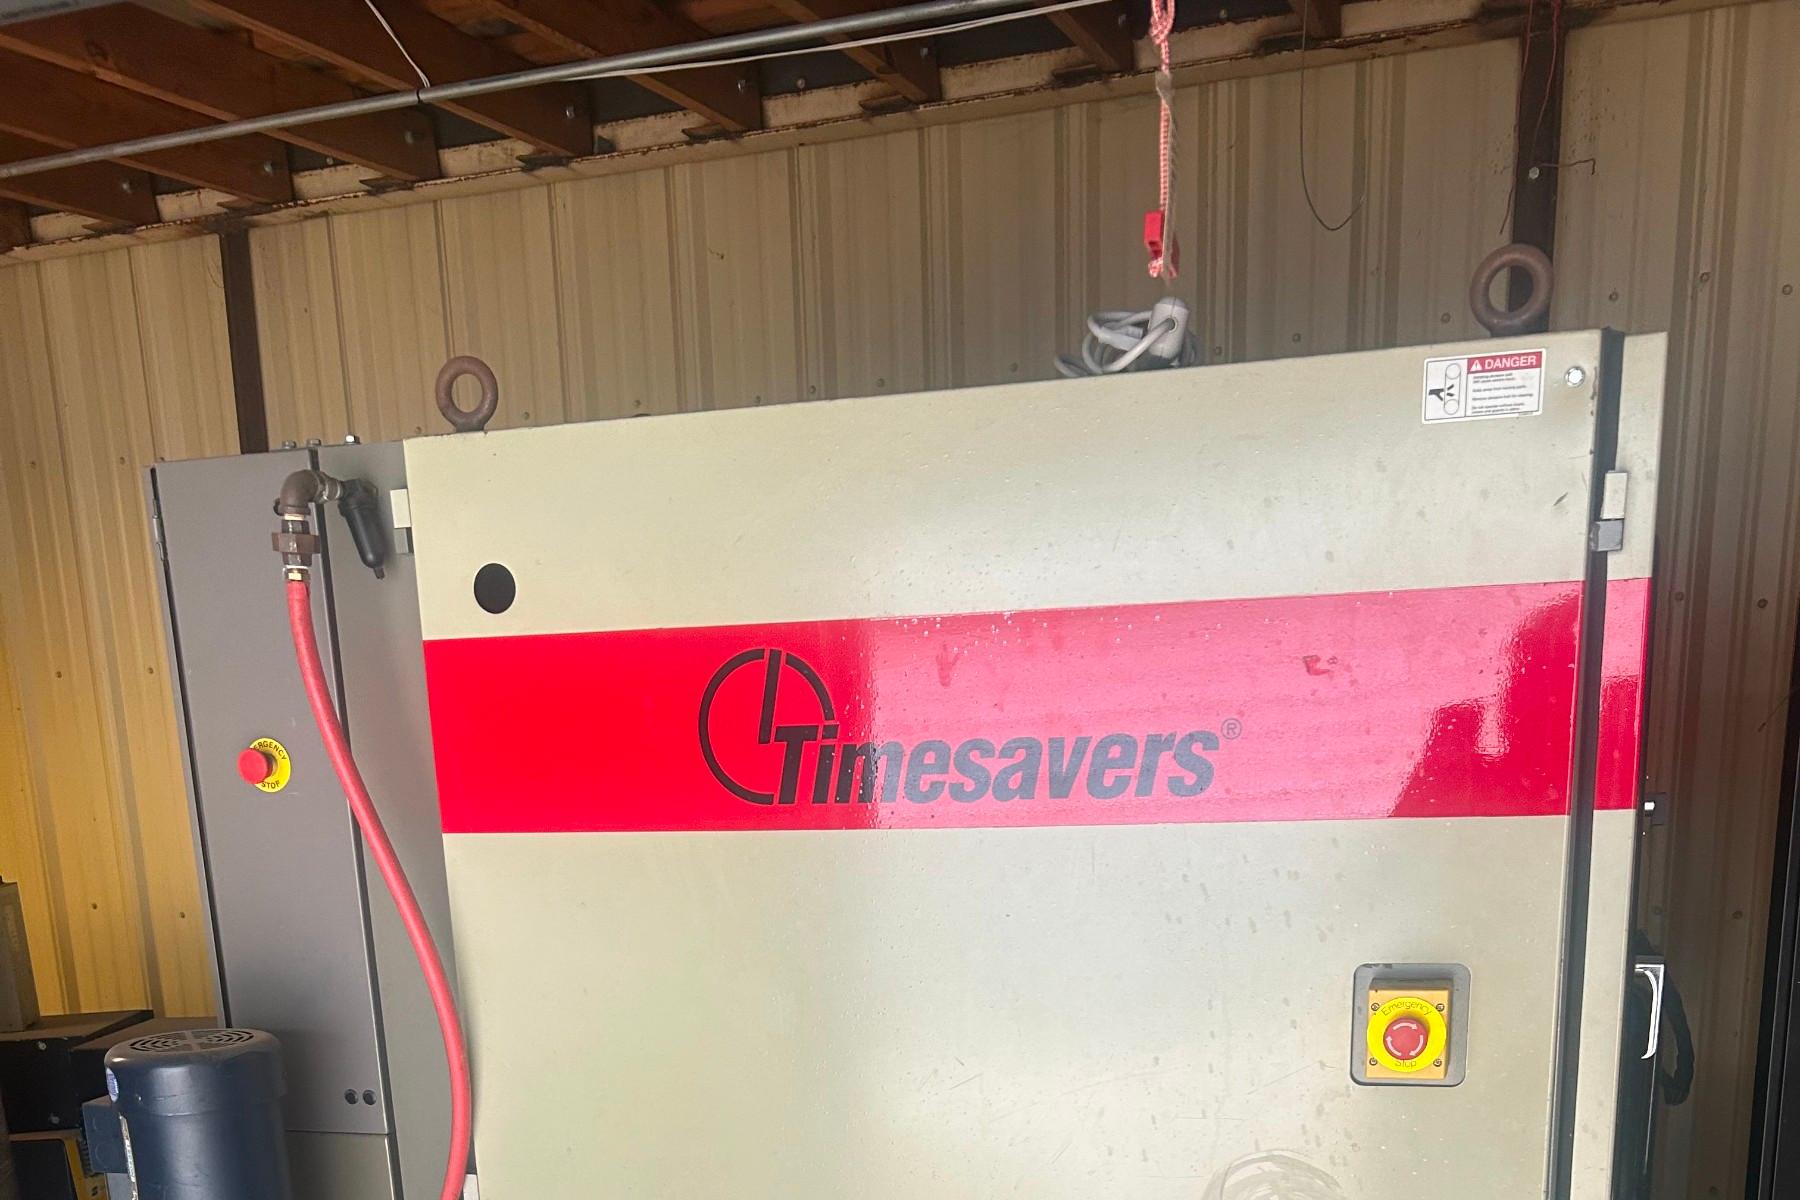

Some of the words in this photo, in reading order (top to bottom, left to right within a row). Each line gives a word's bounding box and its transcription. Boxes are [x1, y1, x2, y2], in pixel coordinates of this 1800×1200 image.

[1485, 355, 1536, 370] DANGER
[261, 780, 280, 789] STOP
[1381, 1002, 1432, 1016] Emergency
